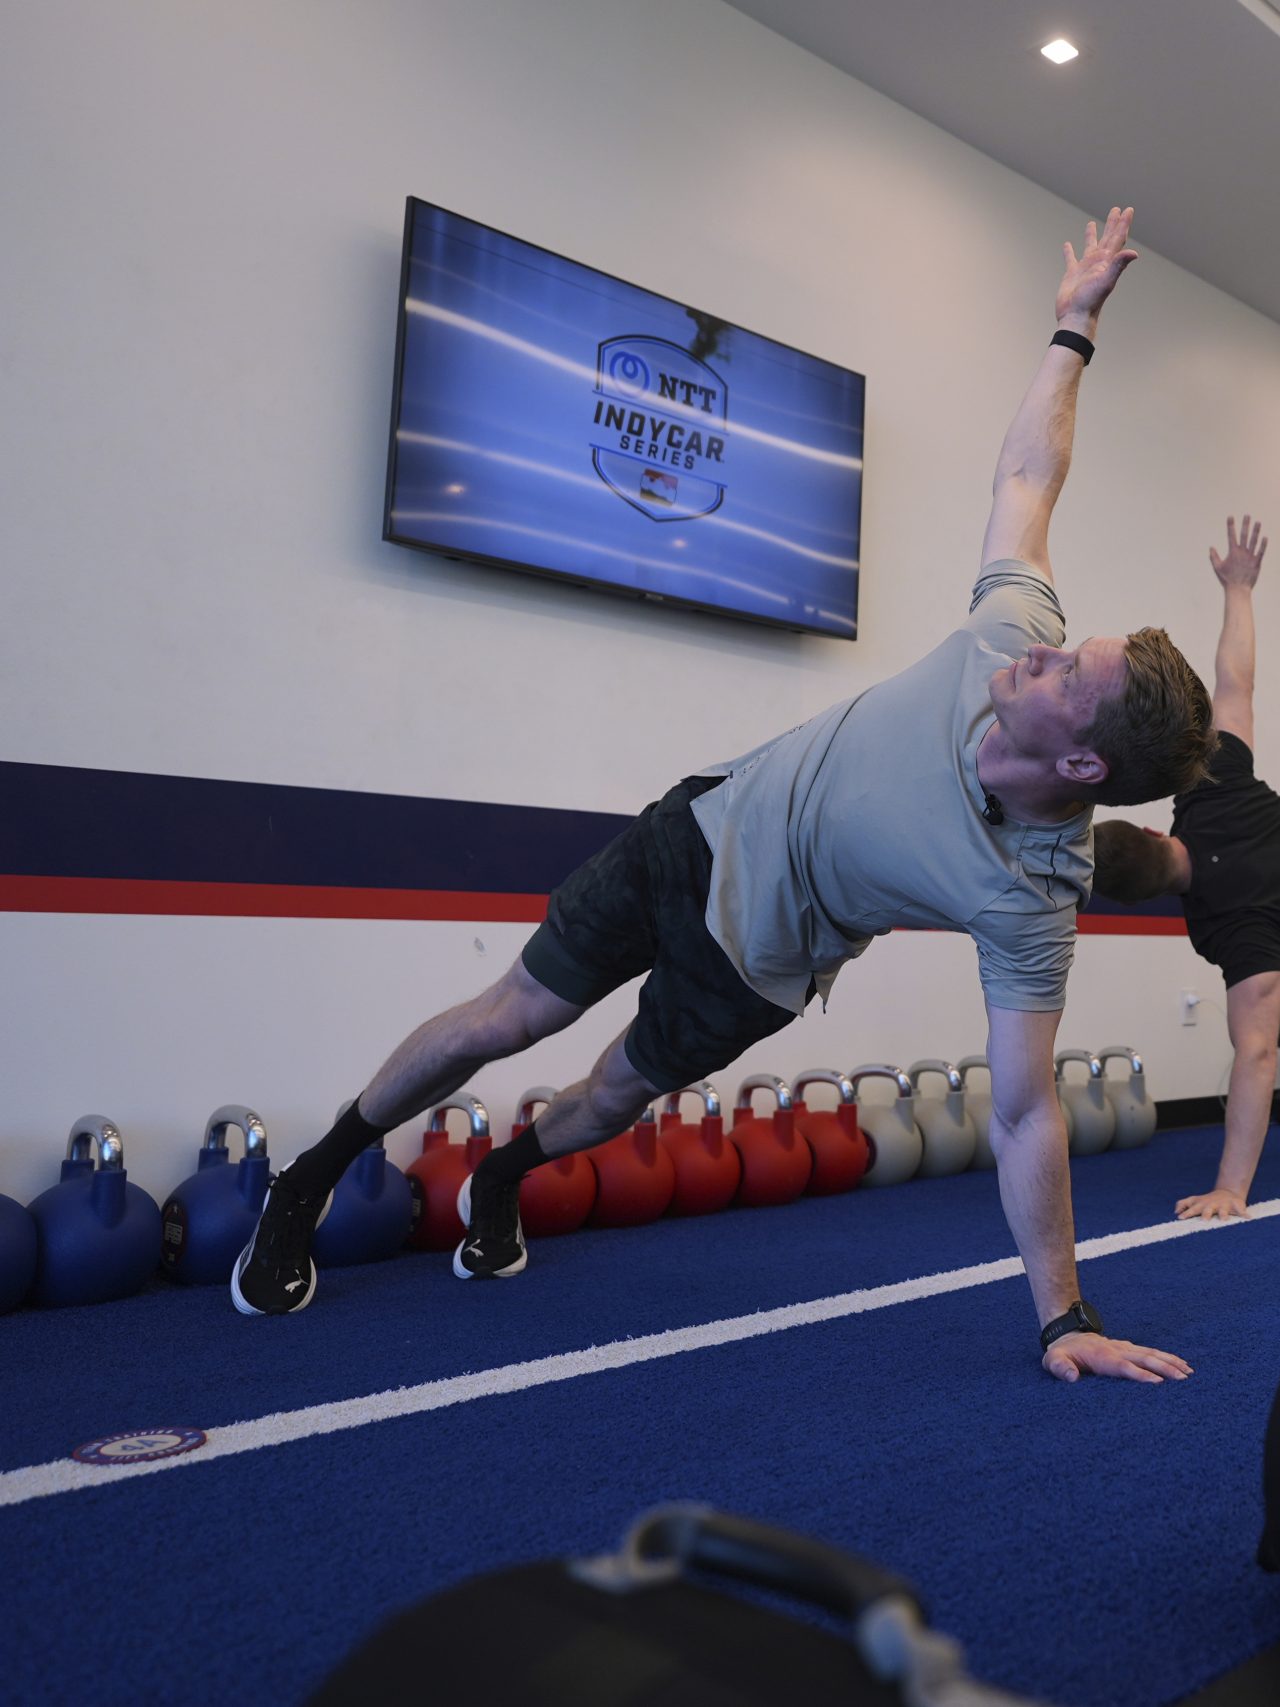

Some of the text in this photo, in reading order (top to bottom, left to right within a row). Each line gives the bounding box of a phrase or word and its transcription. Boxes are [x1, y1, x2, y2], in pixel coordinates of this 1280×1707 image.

[659, 373, 716, 413] NTT
[594, 401, 725, 463] INDYCAR
[620, 435, 695, 470] SERIES
